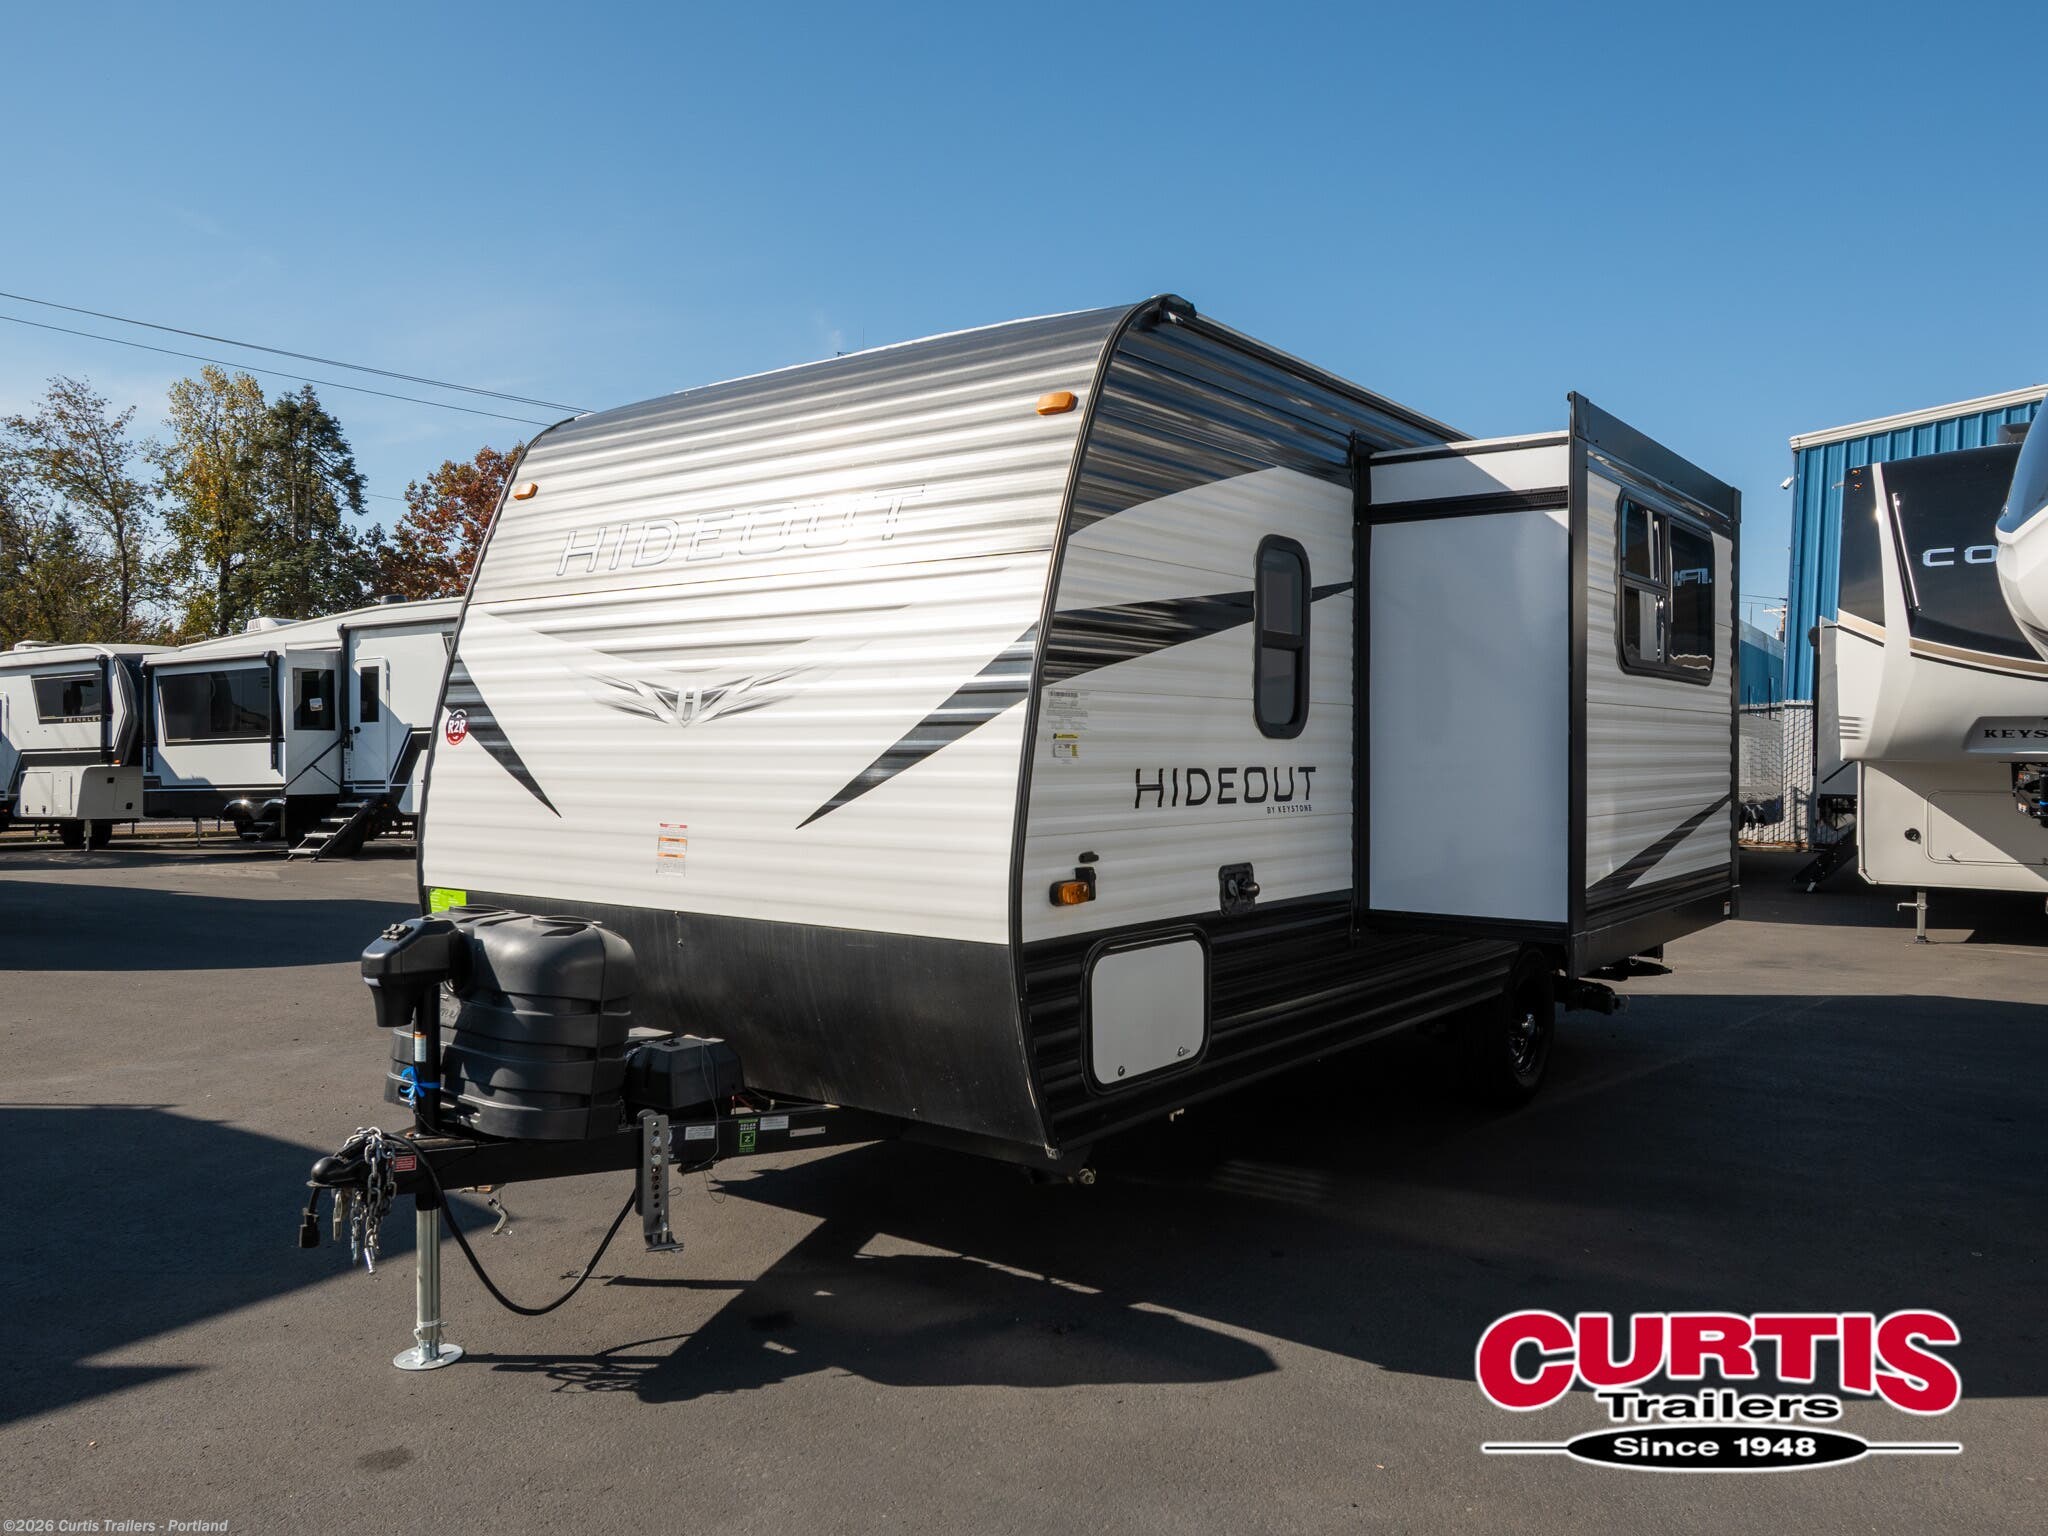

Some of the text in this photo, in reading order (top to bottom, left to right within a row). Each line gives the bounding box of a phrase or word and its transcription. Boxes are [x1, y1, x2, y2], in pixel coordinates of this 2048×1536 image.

[556, 484, 927, 577] HIDEOUT
[447, 719, 466, 734] R2R
[1134, 766, 1317, 809] HIDEOUT
[1266, 803, 1313, 815] BY KEYSTONE
